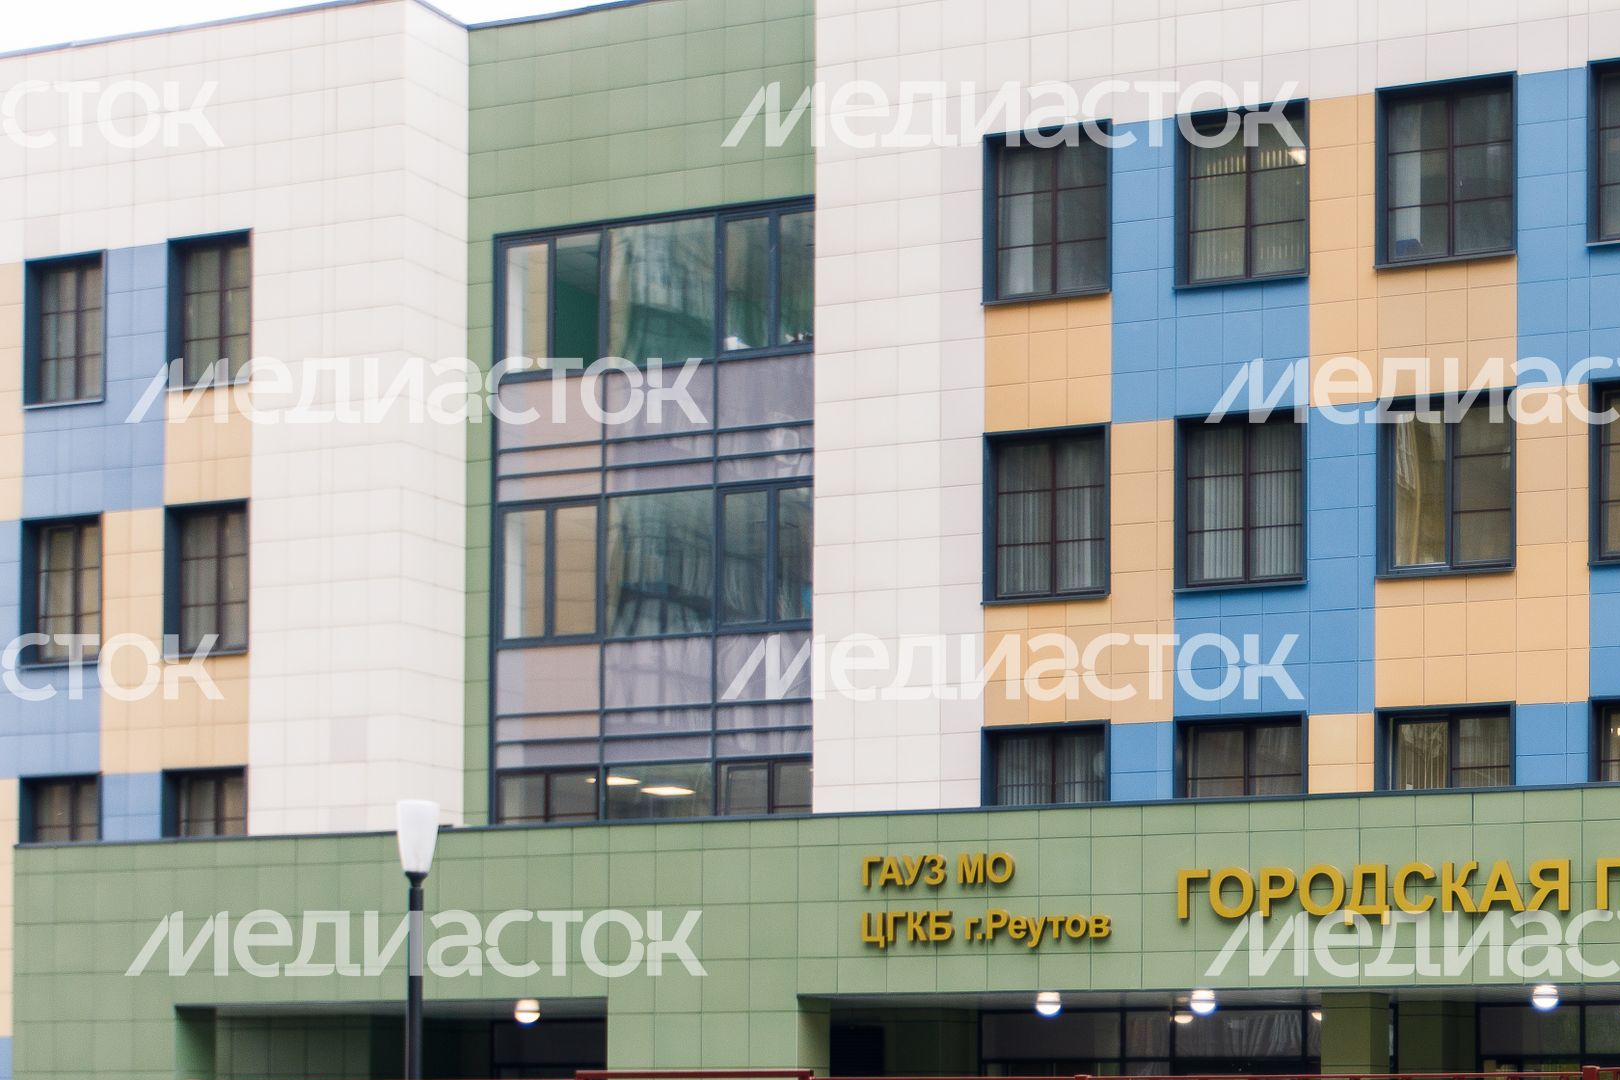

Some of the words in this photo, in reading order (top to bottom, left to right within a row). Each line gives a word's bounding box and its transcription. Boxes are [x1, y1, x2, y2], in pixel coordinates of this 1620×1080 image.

[861, 853, 948, 888] ГАУЗ
[957, 852, 1016, 885] МО
[1176, 858, 1572, 927] ГОРОДСКАЯ
[861, 909, 955, 948] ЦГКБ
